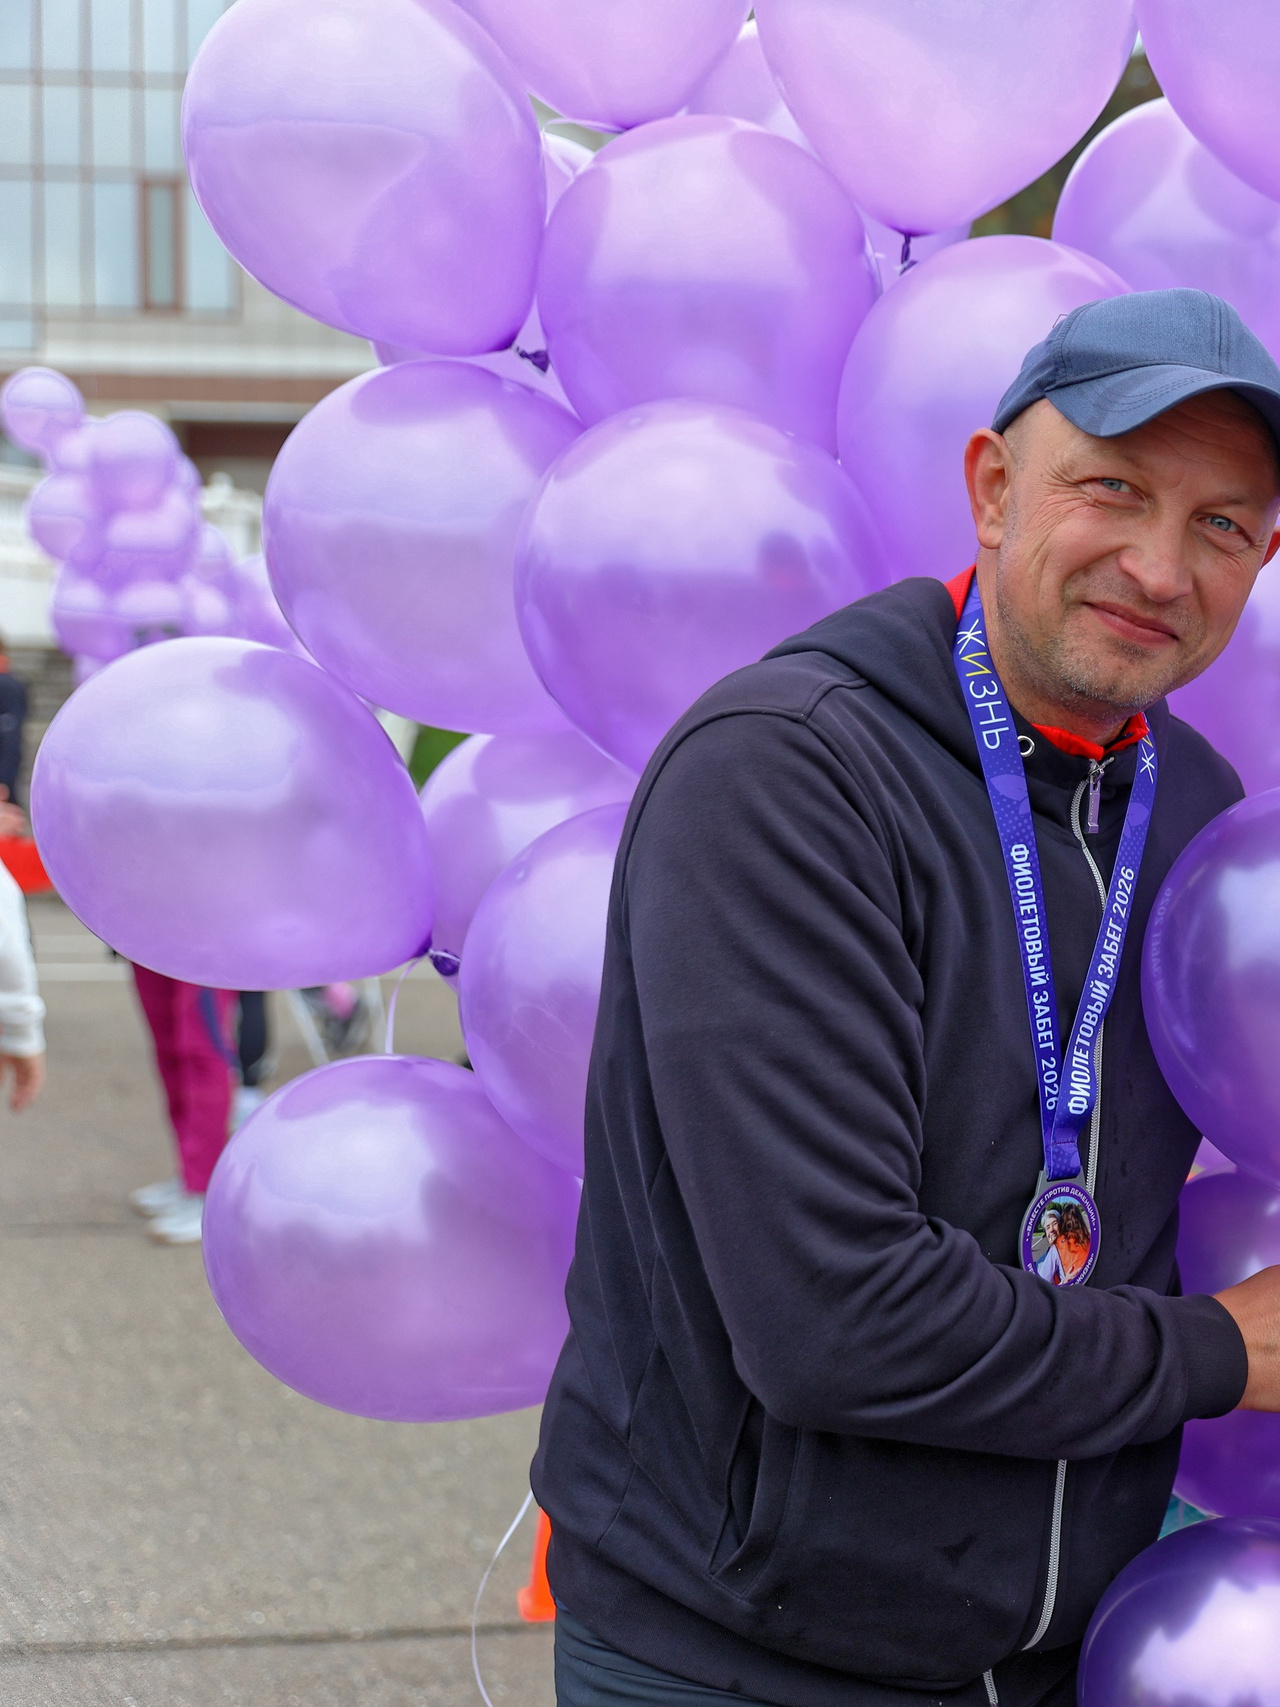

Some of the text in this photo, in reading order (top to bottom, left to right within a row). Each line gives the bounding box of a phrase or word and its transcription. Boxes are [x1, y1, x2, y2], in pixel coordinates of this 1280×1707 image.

[956, 618, 1010, 750] ЖИЗНЬ
[1010, 843, 1060, 1111] ФИОЛЕТОВЫЙ ЗАБЕГ 2026
[1067, 866, 1135, 1115] ФИОЛЕТОВЫЙ ЗАБЕГ 2026
[1044, 1186, 1070, 1202] ПРОТИВ
